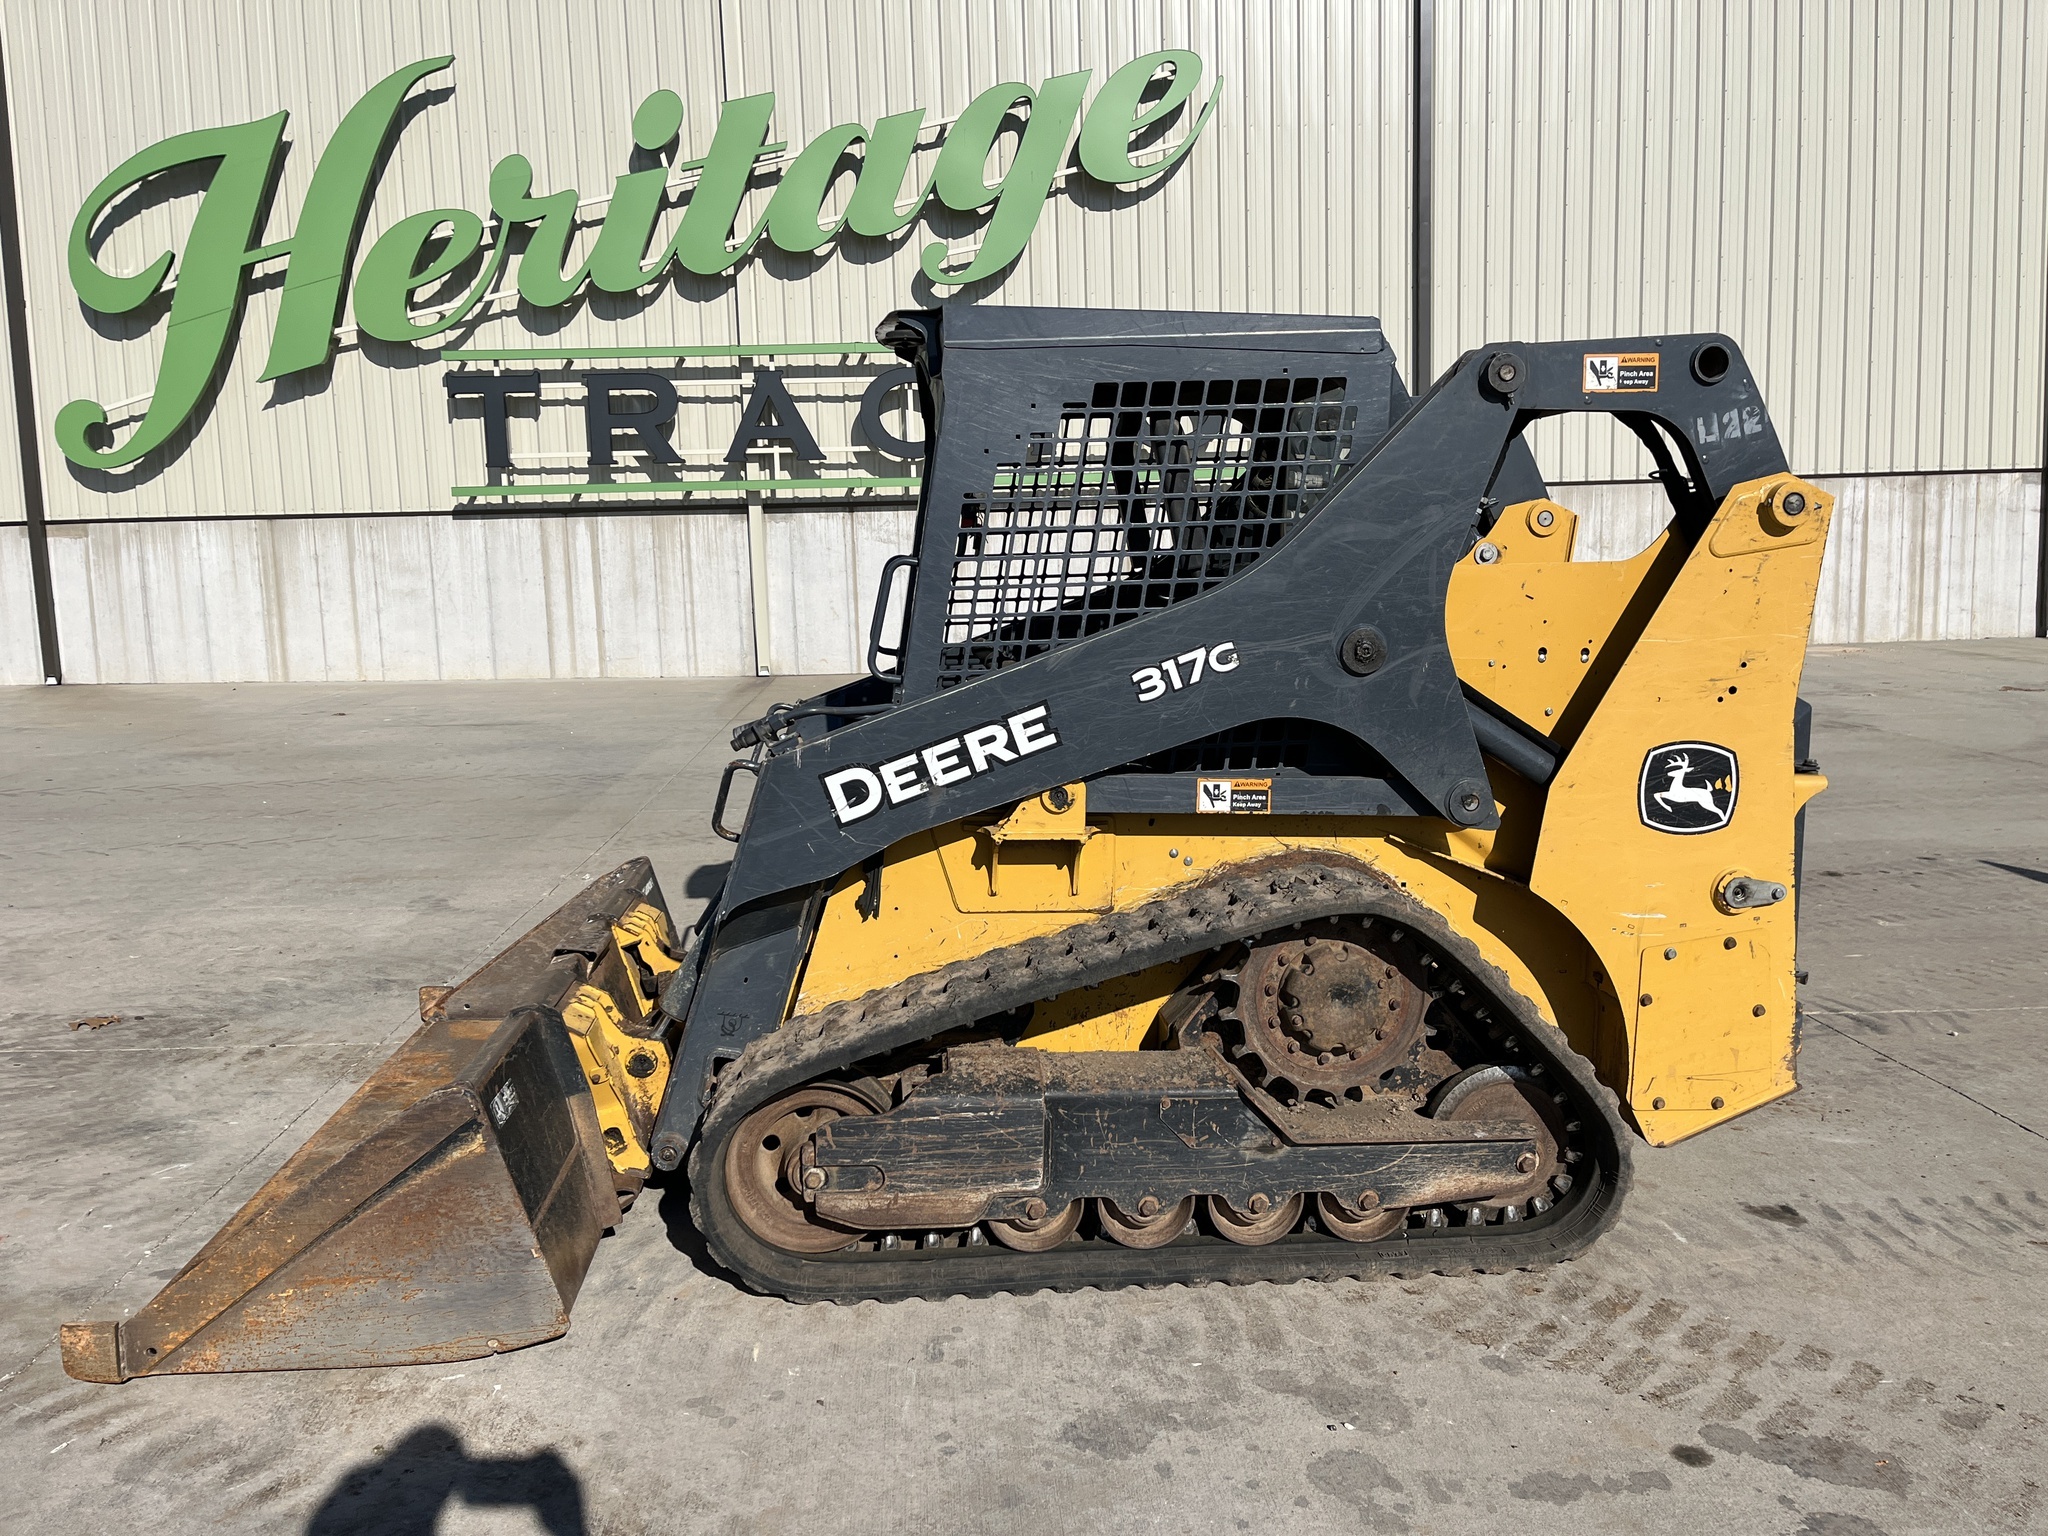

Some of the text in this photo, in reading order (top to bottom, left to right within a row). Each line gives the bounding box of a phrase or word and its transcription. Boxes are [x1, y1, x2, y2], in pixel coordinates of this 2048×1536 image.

[55, 49, 1223, 470] Heritage
[1131, 641, 1240, 702] 317G
[824, 704, 1058, 824] DEERE
[1246, 801, 1262, 809] Away
